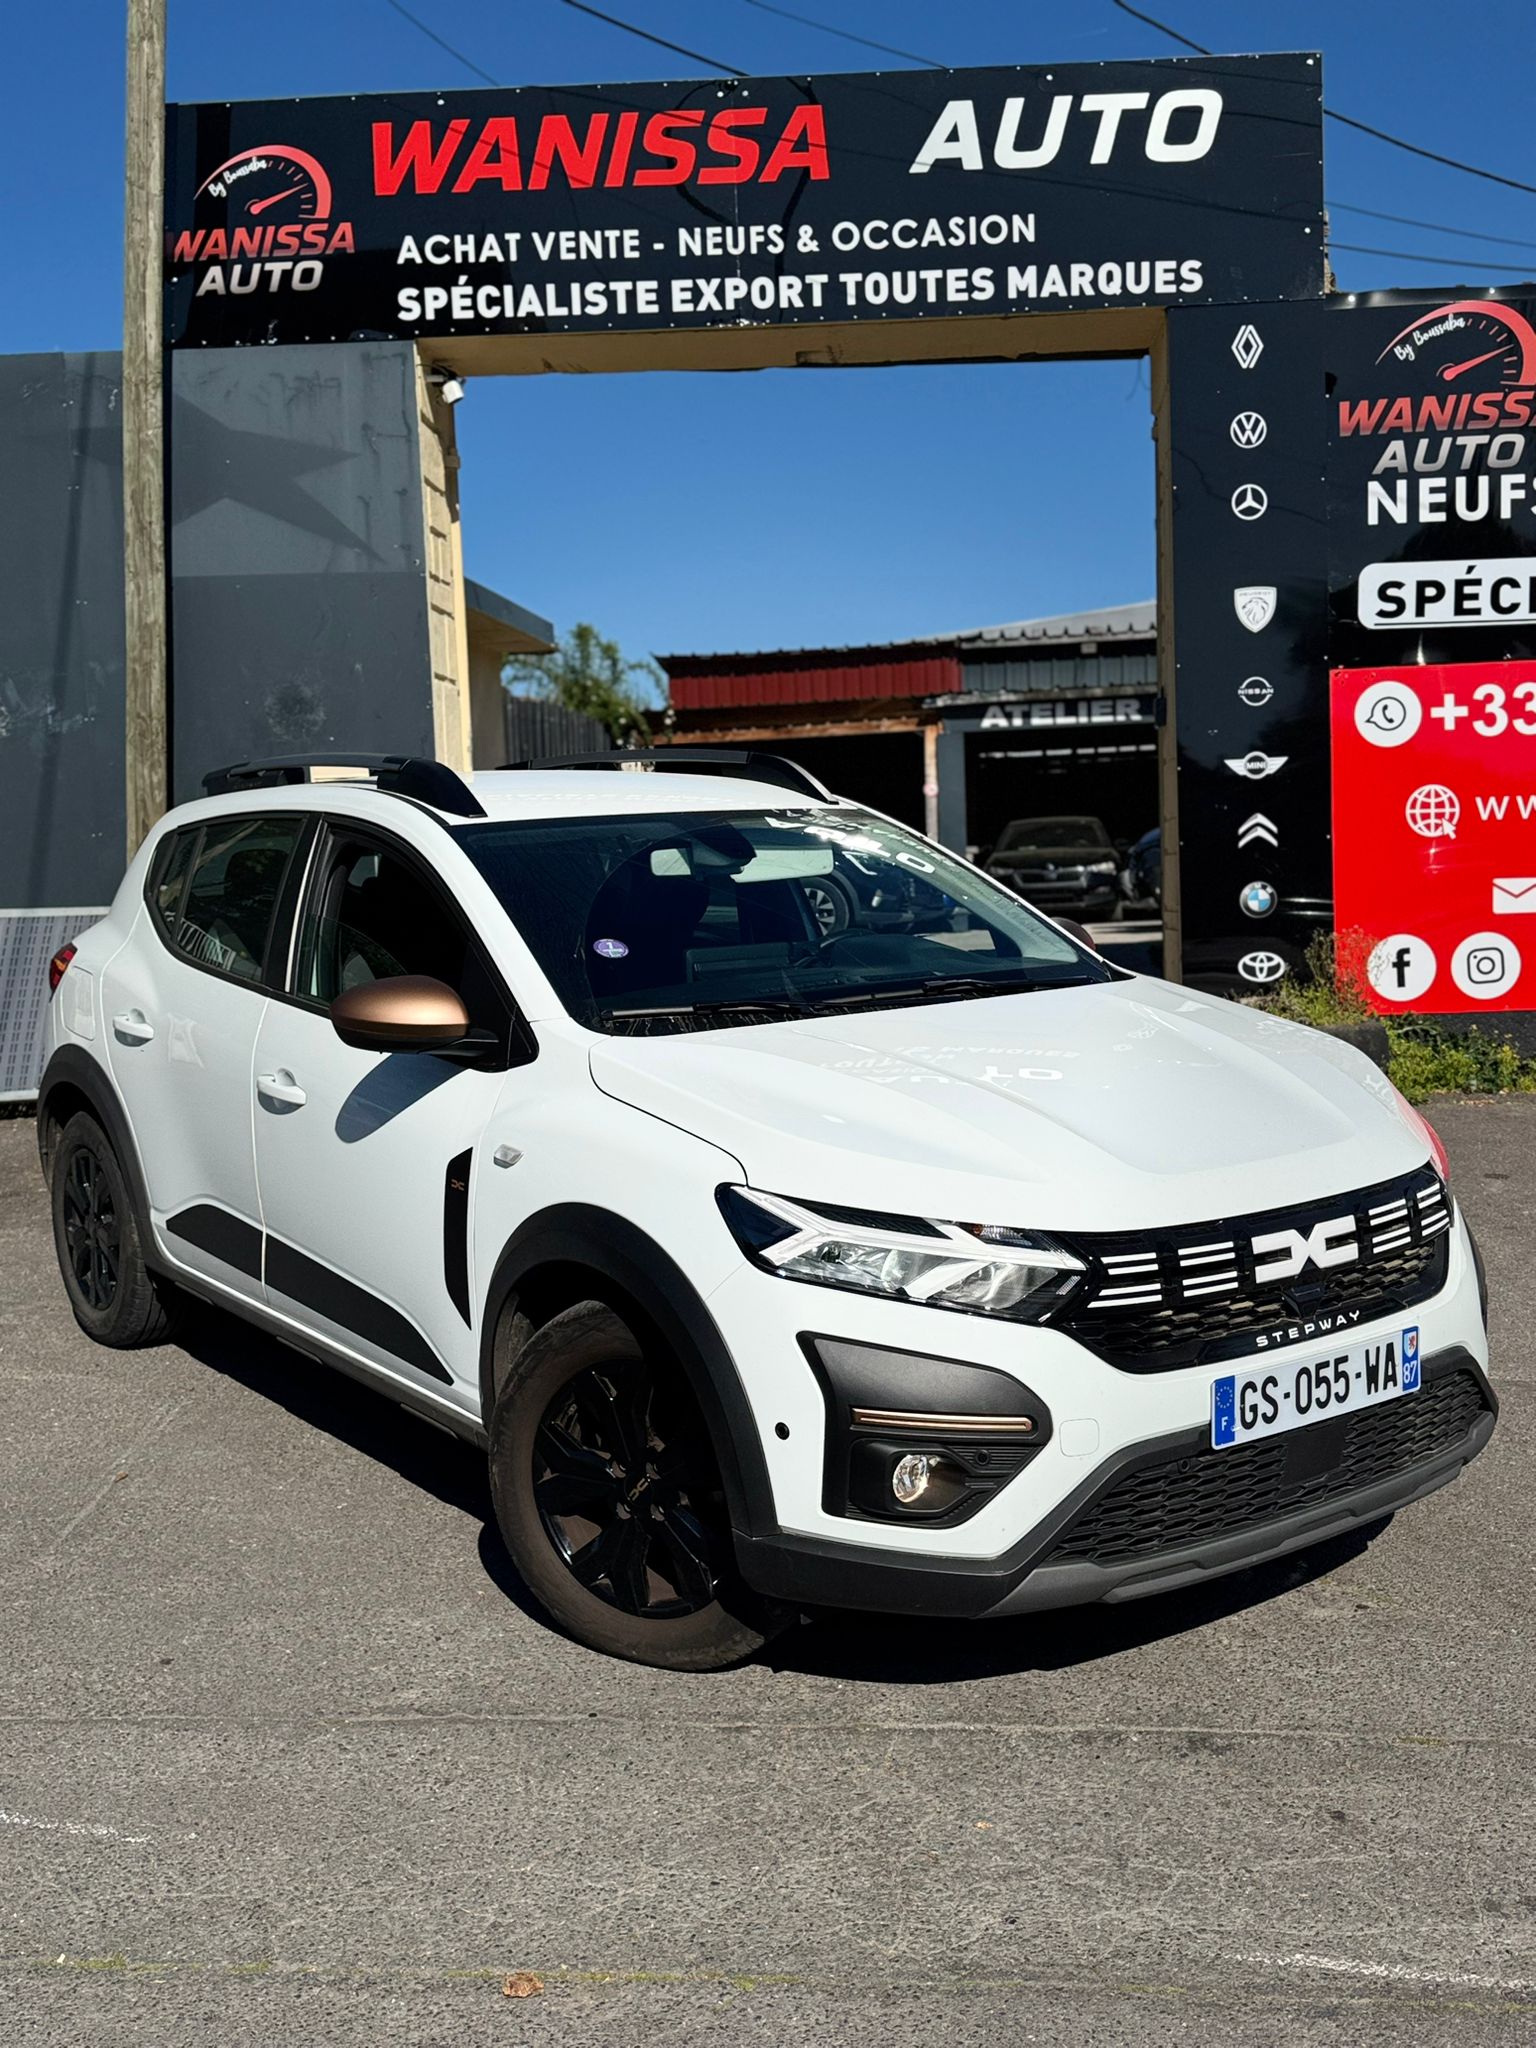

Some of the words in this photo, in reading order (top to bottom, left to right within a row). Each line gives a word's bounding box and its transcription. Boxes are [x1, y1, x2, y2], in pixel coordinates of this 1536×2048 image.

[372, 105, 829, 195] WANISSA
[909, 88, 1223, 174] AUTO
[397, 232, 521, 265] ACHAT
[531, 229, 640, 261] VENTE
[678, 224, 785, 257] NEUFS
[796, 224, 820, 253] &
[831, 213, 1036, 251] OCCASION
[196, 260, 323, 297] AUTO
[397, 275, 659, 321] SPÉCIALISTE
[671, 274, 828, 313] EXPORT
[839, 267, 995, 306] TOUTES
[1007, 260, 1203, 299] MARQUES
[1394, 343, 1415, 361] By
[1412, 312, 1466, 347] Boussaba
[1339, 391, 1536, 437] WANISS
[1372, 433, 1525, 475] AUTO
[1367, 474, 1536, 525] NEUF
[980, 699, 1142, 728] ATELIER
[1256, 1310, 1360, 1347] STEPWAY
[1221, 1416, 1228, 1431] F
[1240, 1342, 1397, 1430] GS-055-WA
[1403, 1360, 1417, 1384] 87
